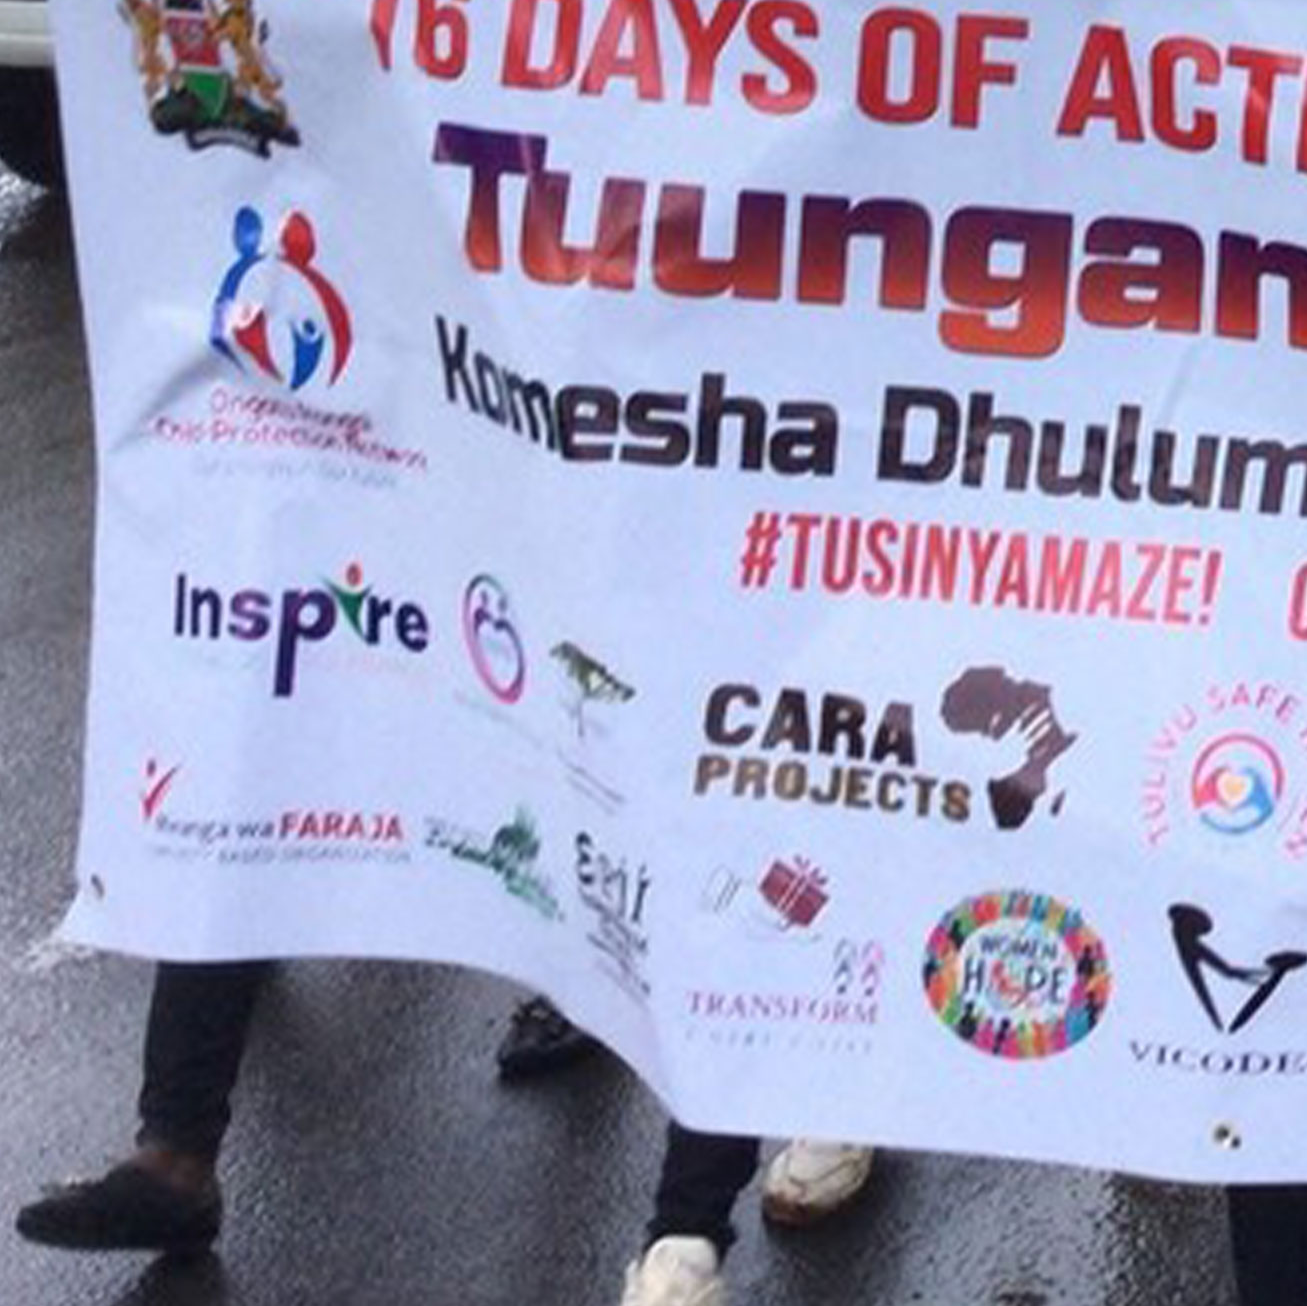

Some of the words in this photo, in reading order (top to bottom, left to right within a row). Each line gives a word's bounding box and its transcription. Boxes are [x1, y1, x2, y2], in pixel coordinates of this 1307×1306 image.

[854, 6, 1030, 129] OF
[433, 314, 838, 477] Komesha
[740, 510, 1224, 626] #TUSINYAMAZE!
[702, 682, 917, 767] CARA
[1206, 681, 1301, 725] SAFE
[278, 811, 404, 841] FARAJA
[693, 754, 972, 823] PROJECTS
[685, 991, 879, 1025] TRANSFORM
